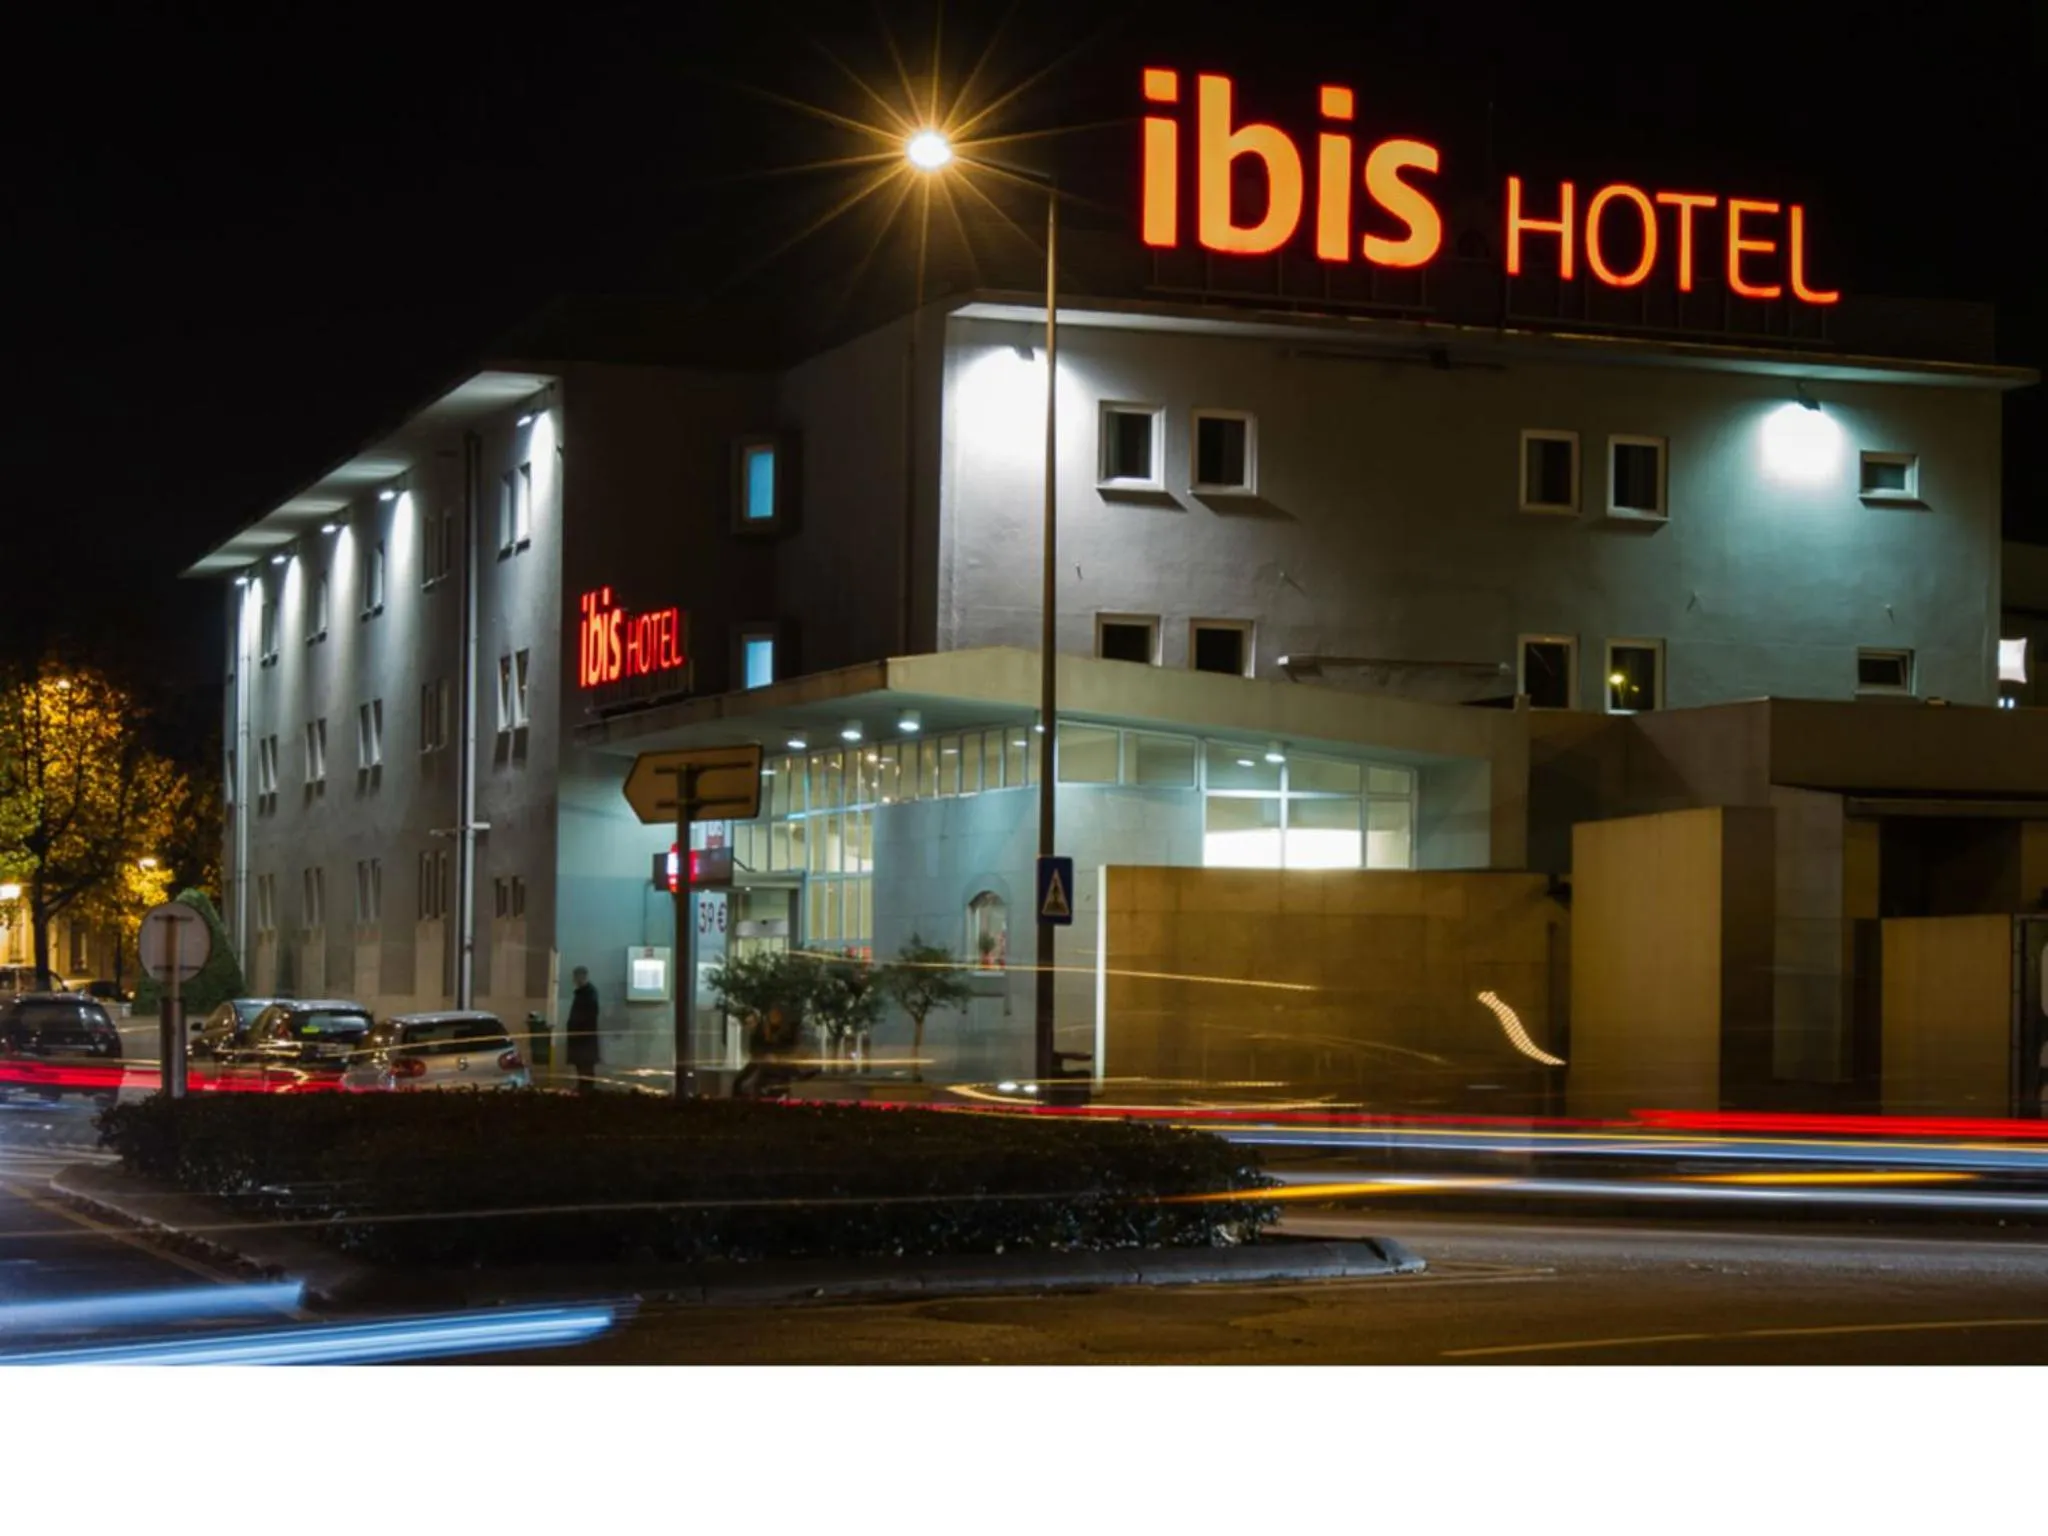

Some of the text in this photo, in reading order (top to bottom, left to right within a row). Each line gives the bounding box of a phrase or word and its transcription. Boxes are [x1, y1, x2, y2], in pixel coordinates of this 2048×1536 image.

[1142, 68, 1839, 304] ibis HOTEL
[580, 587, 683, 687] ibis HOTEL
